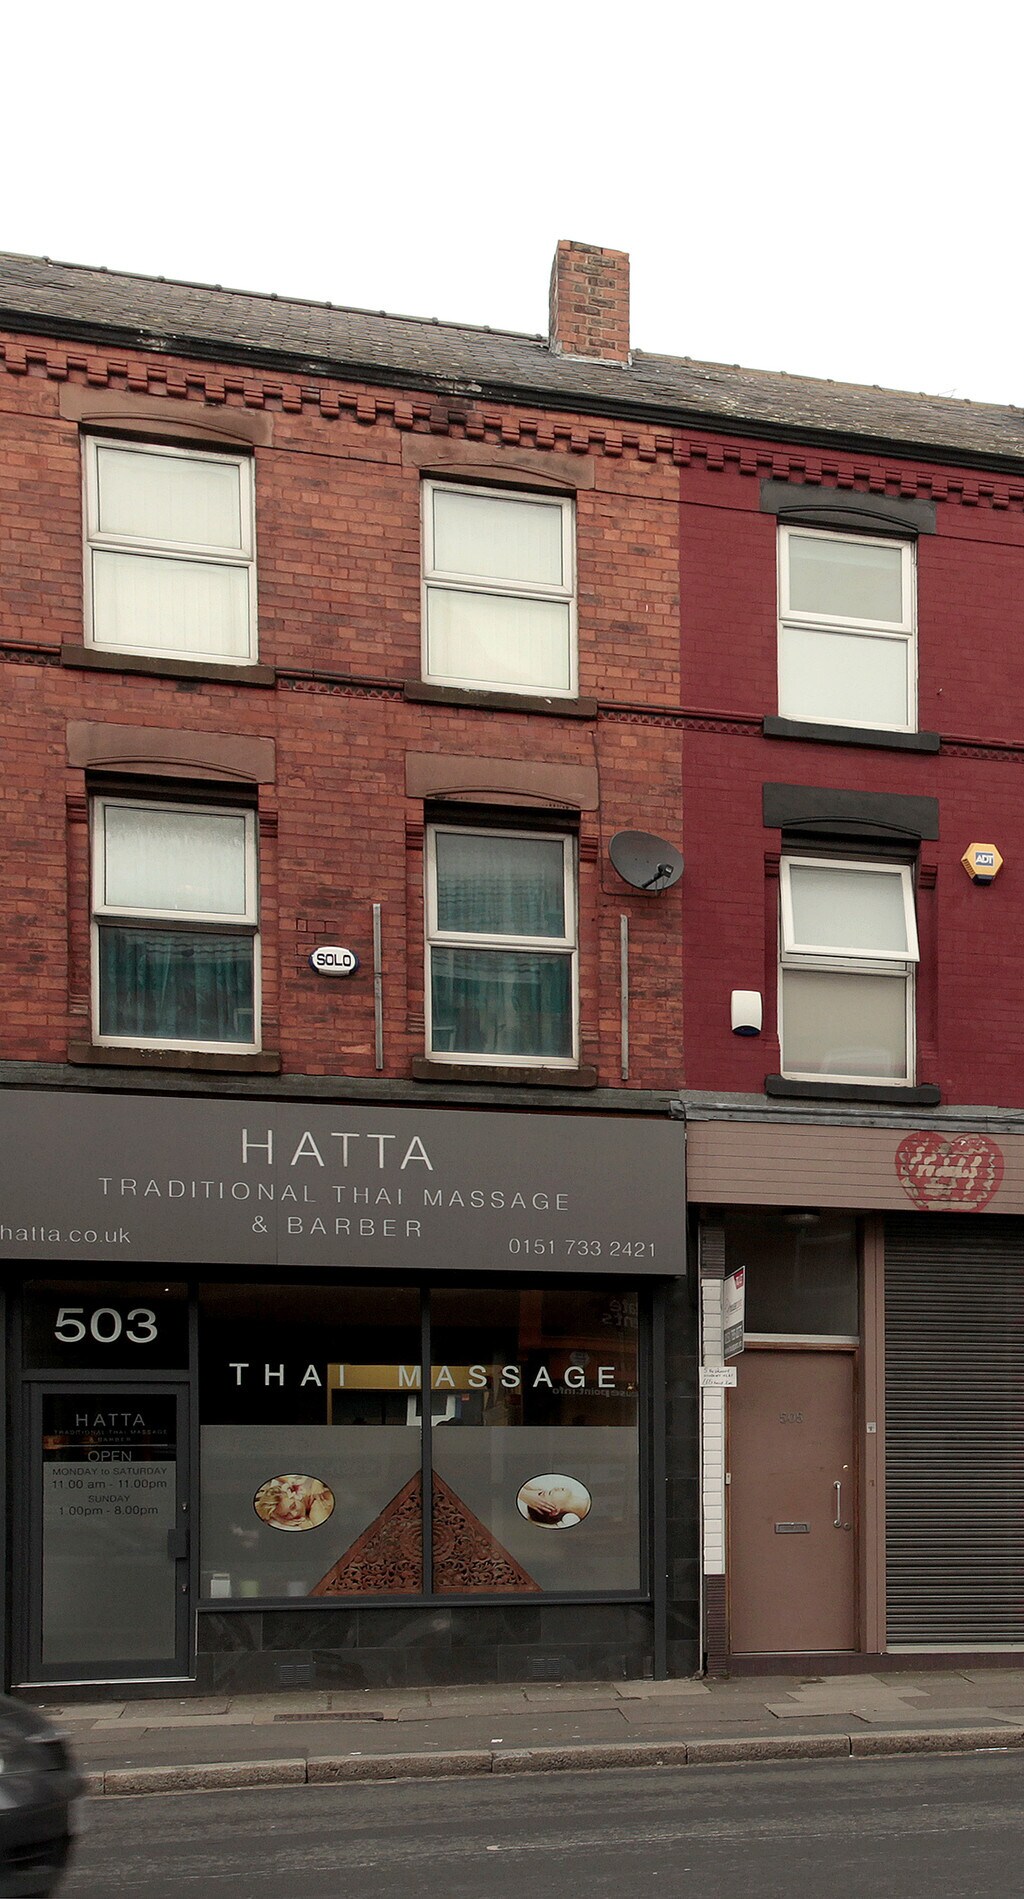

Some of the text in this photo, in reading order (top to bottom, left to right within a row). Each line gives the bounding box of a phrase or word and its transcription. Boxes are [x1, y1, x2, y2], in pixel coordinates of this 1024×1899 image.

[976, 855, 993, 864] ADT
[316, 954, 351, 966] SOLO
[242, 1128, 434, 1171] HATTA
[98, 1176, 569, 1212] TRADITIONAL THAI MASSAGE
[251, 1216, 423, 1239] & BARBER
[508, 1237, 656, 1258] 0151 733 2421
[54, 1308, 158, 1343] 503
[230, 1363, 616, 1389] THAI MASSAGE
[76, 1414, 146, 1426] HATTA
[88, 1450, 132, 1462] OPEN
[52, 1467, 168, 1476] MONDAY to SATURDAY
[118, 1480, 168, 1490] 11.00pm
[88, 1495, 131, 1503] SUNDAY
[60, 1506, 103, 1516] 1.00pm
[114, 1506, 159, 1516] 8.00pm
